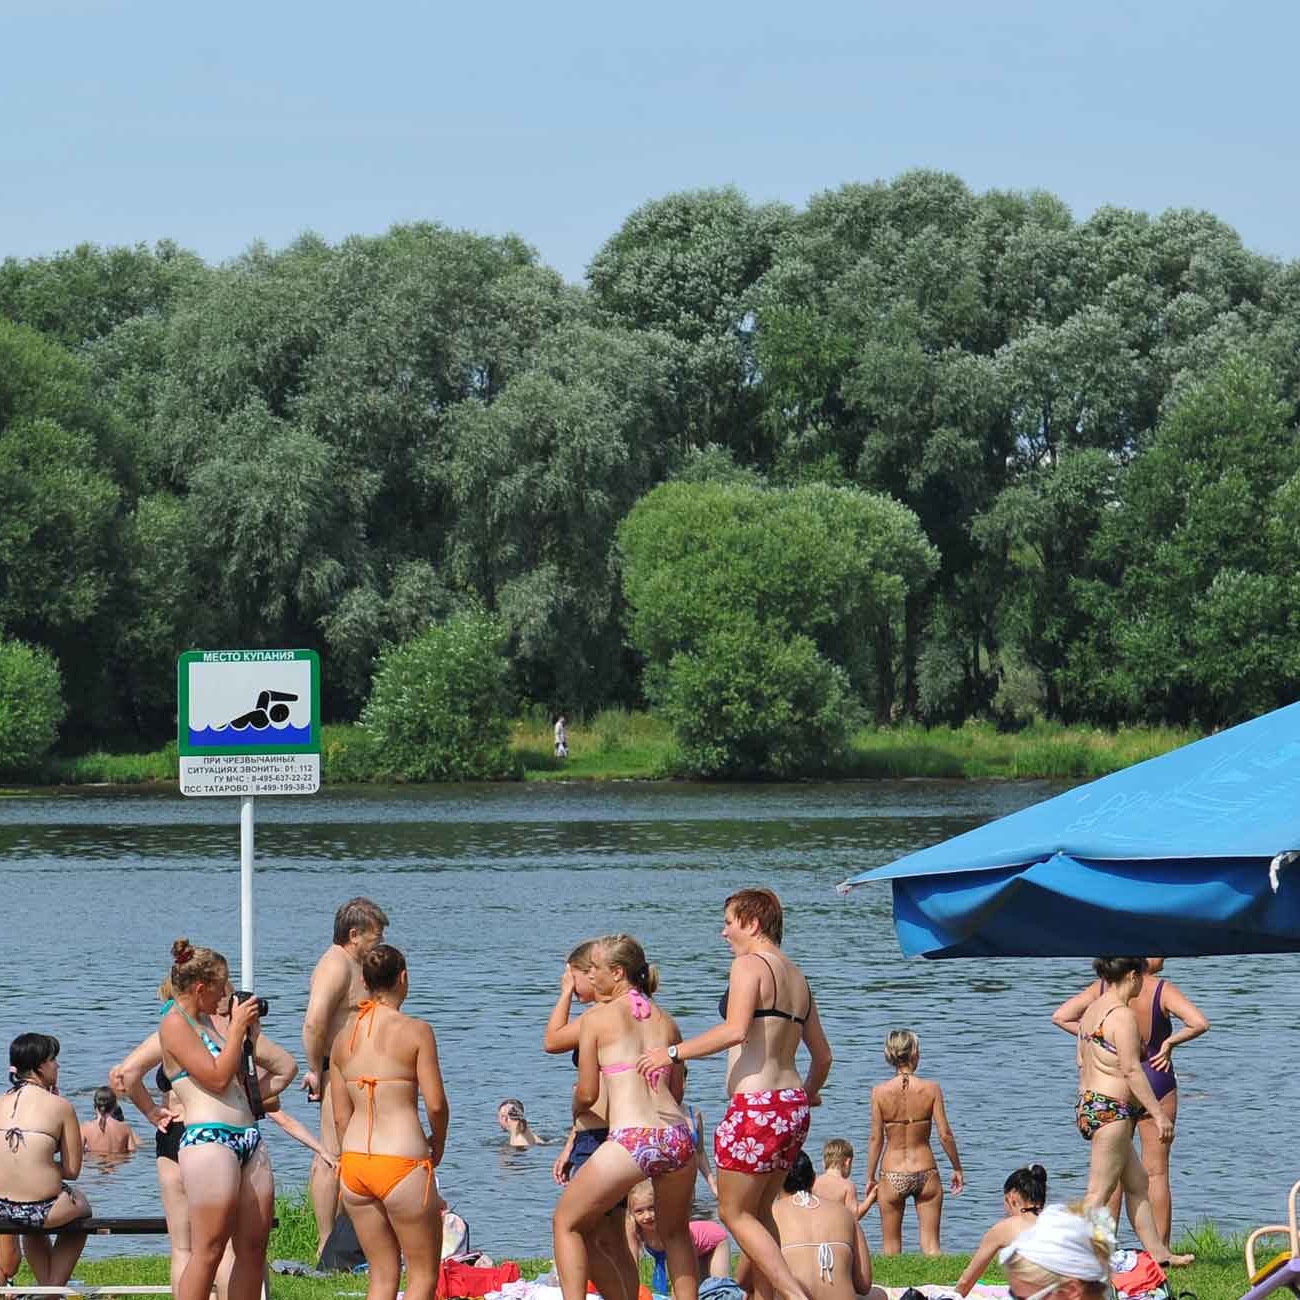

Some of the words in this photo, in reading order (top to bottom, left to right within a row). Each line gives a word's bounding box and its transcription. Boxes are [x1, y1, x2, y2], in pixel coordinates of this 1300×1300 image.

[203, 652, 241, 662] МЕСТО
[243, 651, 295, 661] КУПАНИЯ
[187, 766, 238, 775] СИТУАЦИЯХ
[300, 764, 313, 772] 112
[226, 775, 244, 783] МЧС
[184, 785, 201, 793] ПСС
[204, 784, 249, 793] ТАТАРОВО
